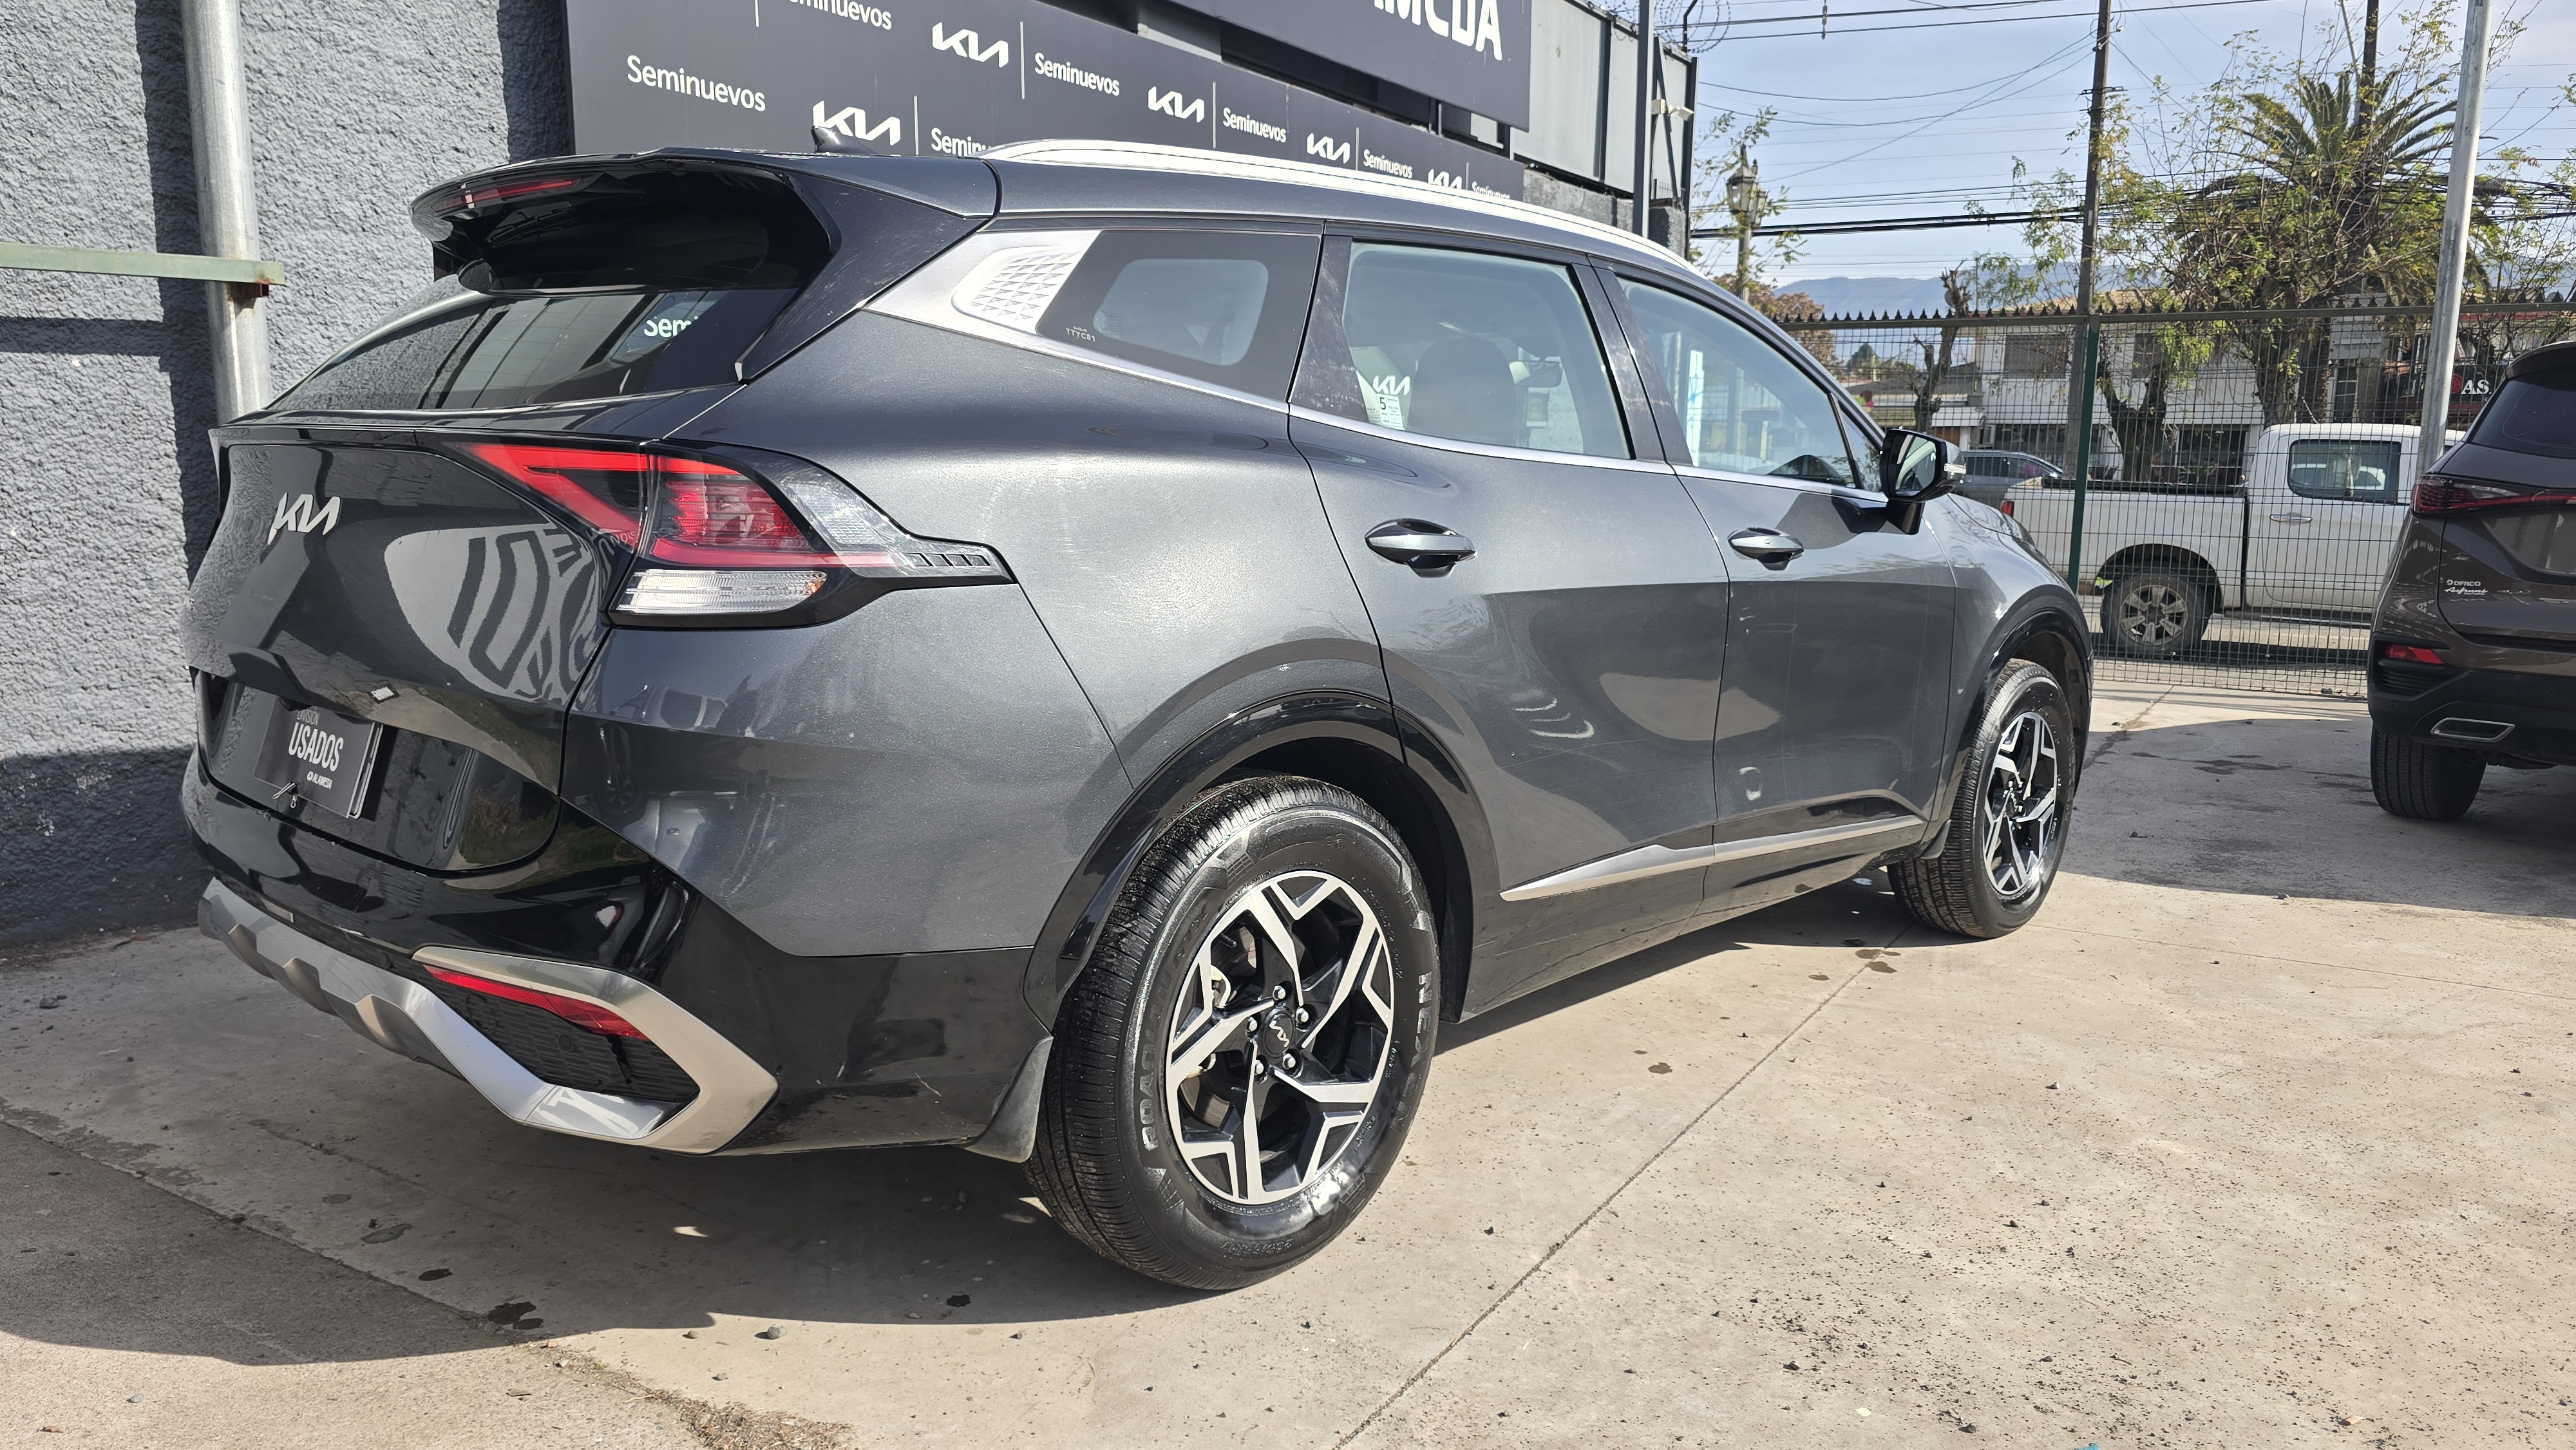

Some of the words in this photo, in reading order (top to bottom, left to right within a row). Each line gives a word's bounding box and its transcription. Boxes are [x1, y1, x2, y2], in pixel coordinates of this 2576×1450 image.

[627, 55, 766, 112] Seminuevos
[1034, 52, 1120, 97] Seminuevos
[1222, 107, 1287, 143] Seminuevos
[1363, 149, 1413, 179] Seminuevos
[1379, 397, 1387, 410] 5
[289, 722, 344, 771] USADOS
[1388, 971, 1433, 1133] NEXEN
